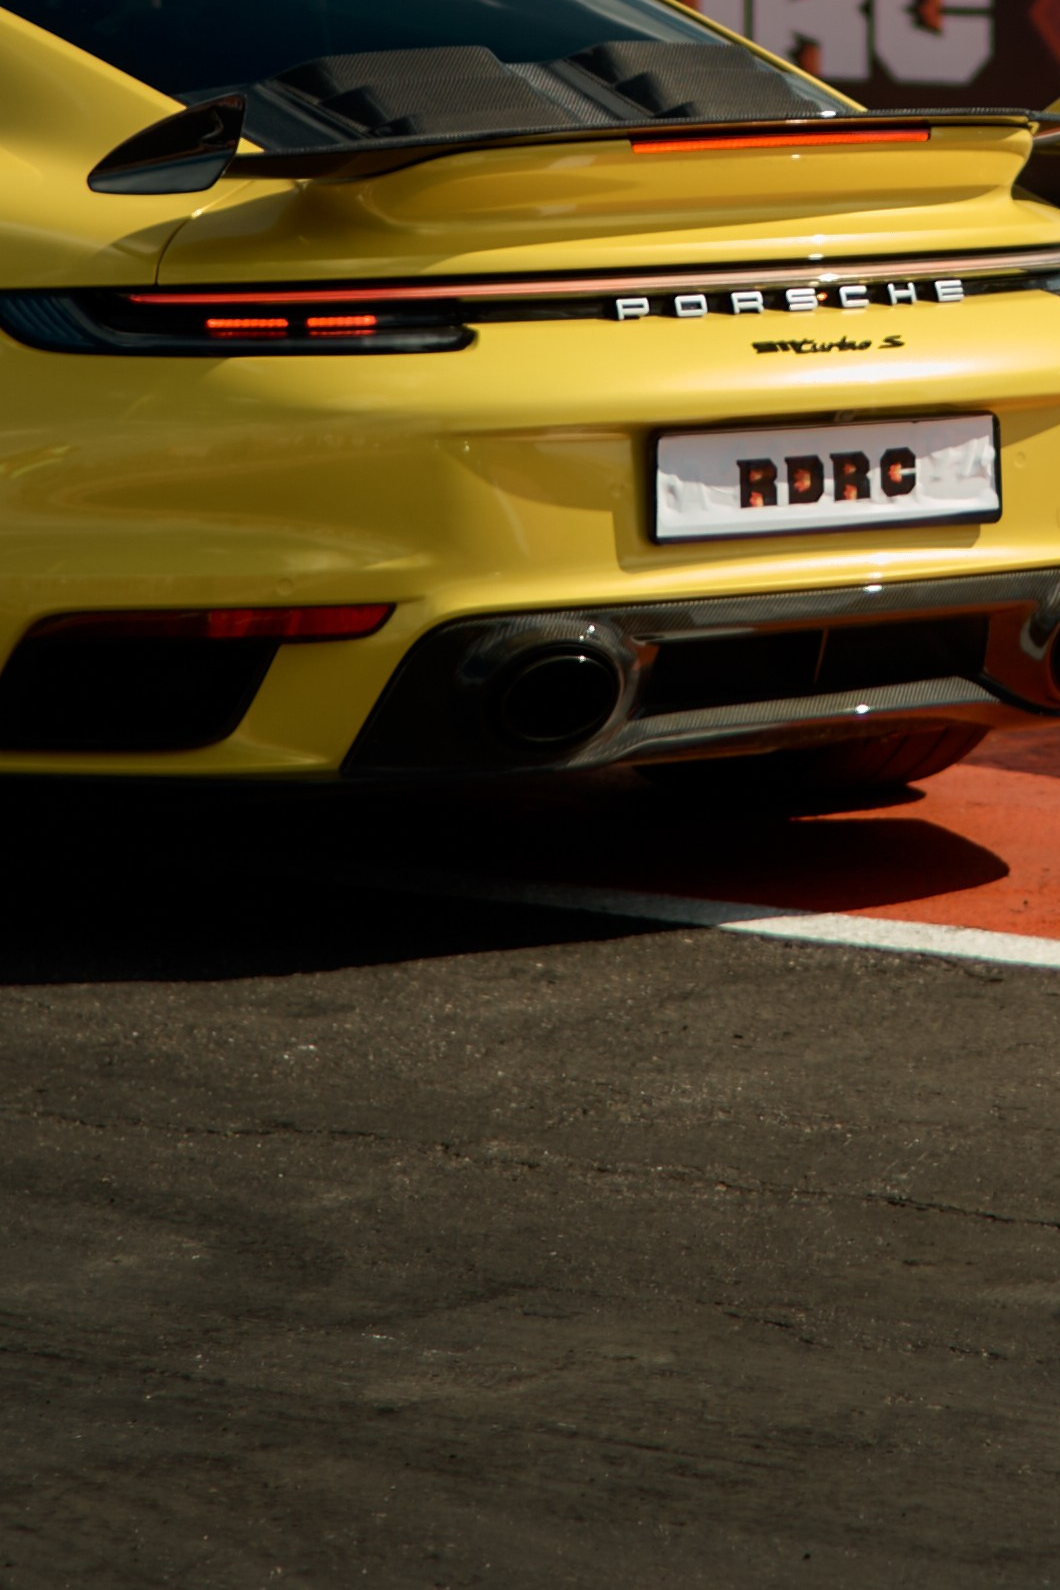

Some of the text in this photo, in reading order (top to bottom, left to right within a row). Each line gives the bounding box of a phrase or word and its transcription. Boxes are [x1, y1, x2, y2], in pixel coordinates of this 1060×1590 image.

[615, 279, 965, 320] PORSCHE
[878, 335, 905, 349] S
[737, 447, 916, 508] RDRC
